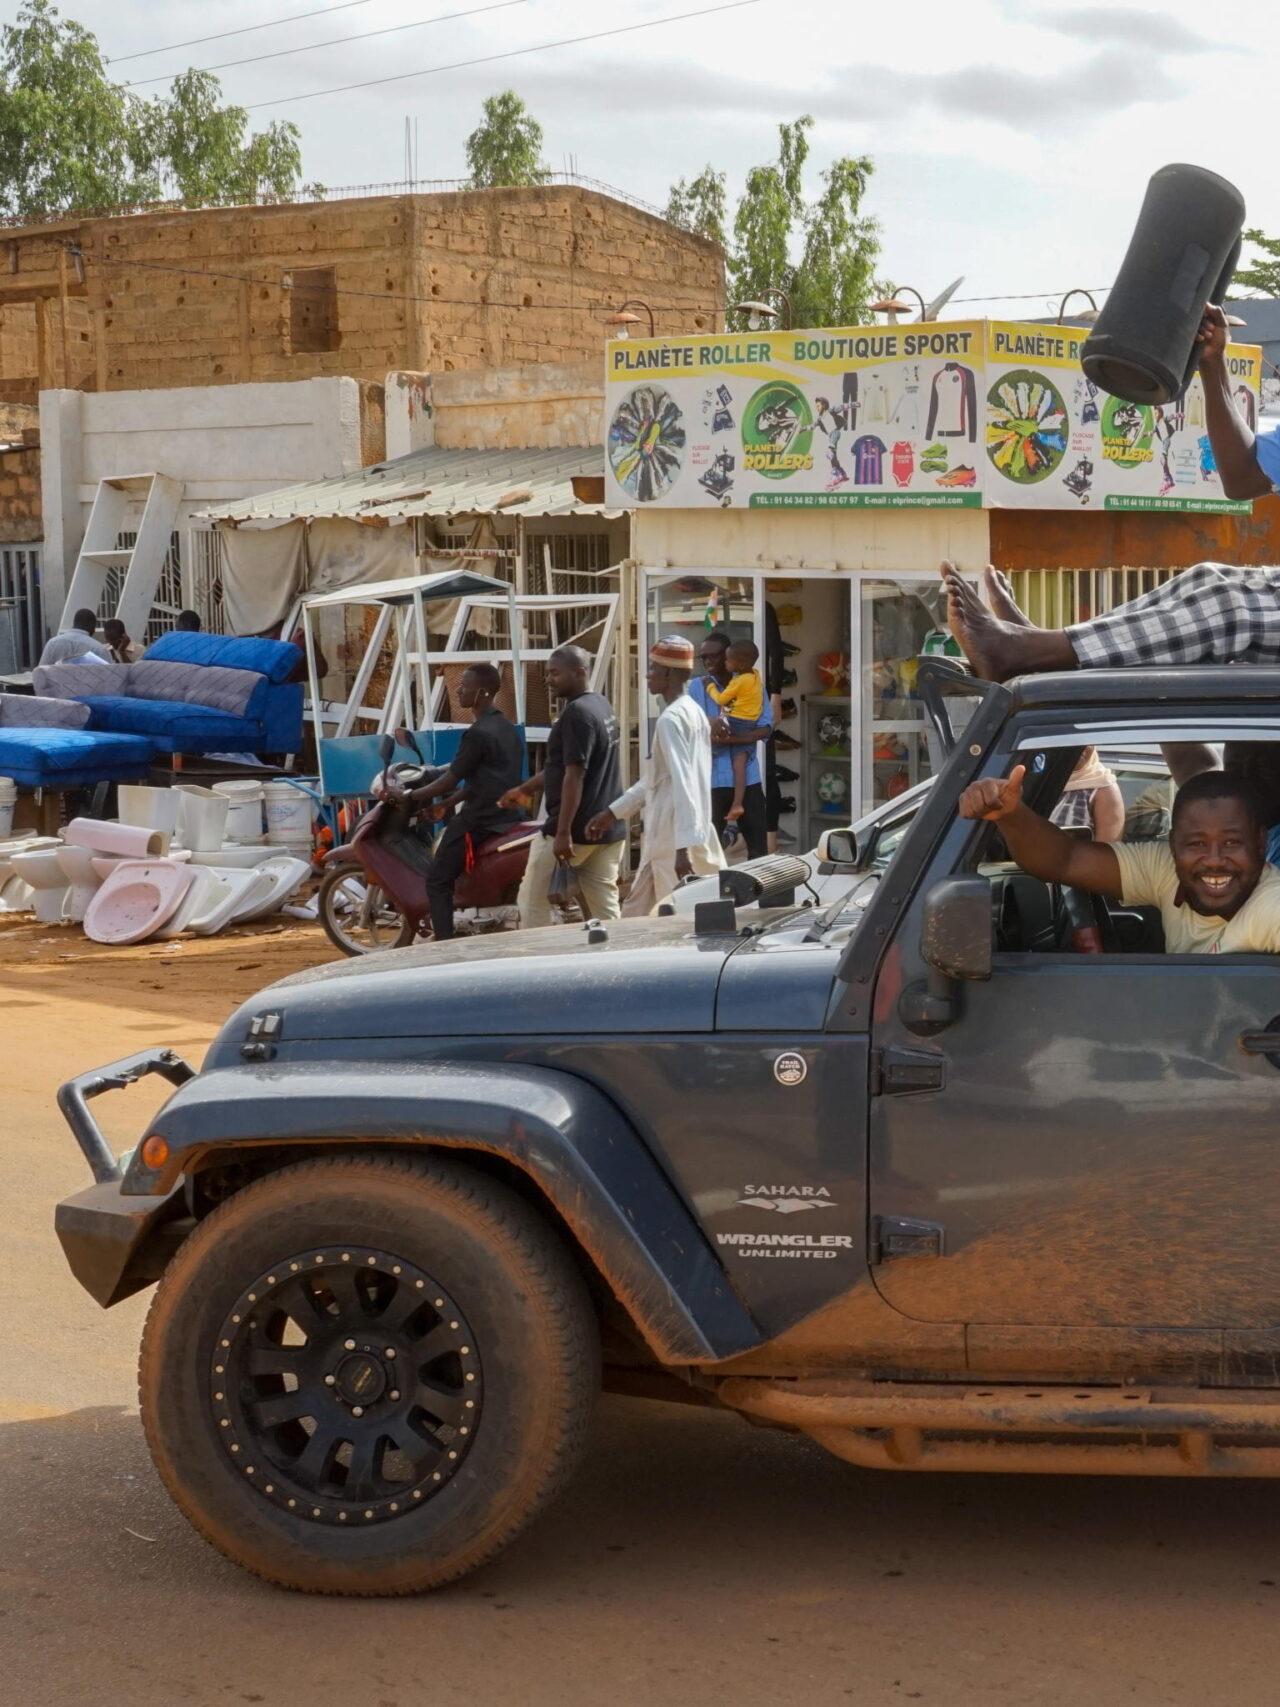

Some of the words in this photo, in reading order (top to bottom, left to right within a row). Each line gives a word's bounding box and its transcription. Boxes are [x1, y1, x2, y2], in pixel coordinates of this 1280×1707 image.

[614, 344, 694, 370] PLANÈTE
[699, 343, 771, 365] ROLLER
[794, 336, 897, 361] BOUTIQUE
[904, 332, 972, 356] SPORT
[1102, 445, 1153, 463] ROLLERS
[743, 453, 814, 471] ROLLERS
[864, 496, 887, 504] E-mail
[744, 1184, 831, 1197] SAHARA
[716, 1233, 853, 1248] WRANGLER
[738, 1249, 838, 1259] UNLIMITED
